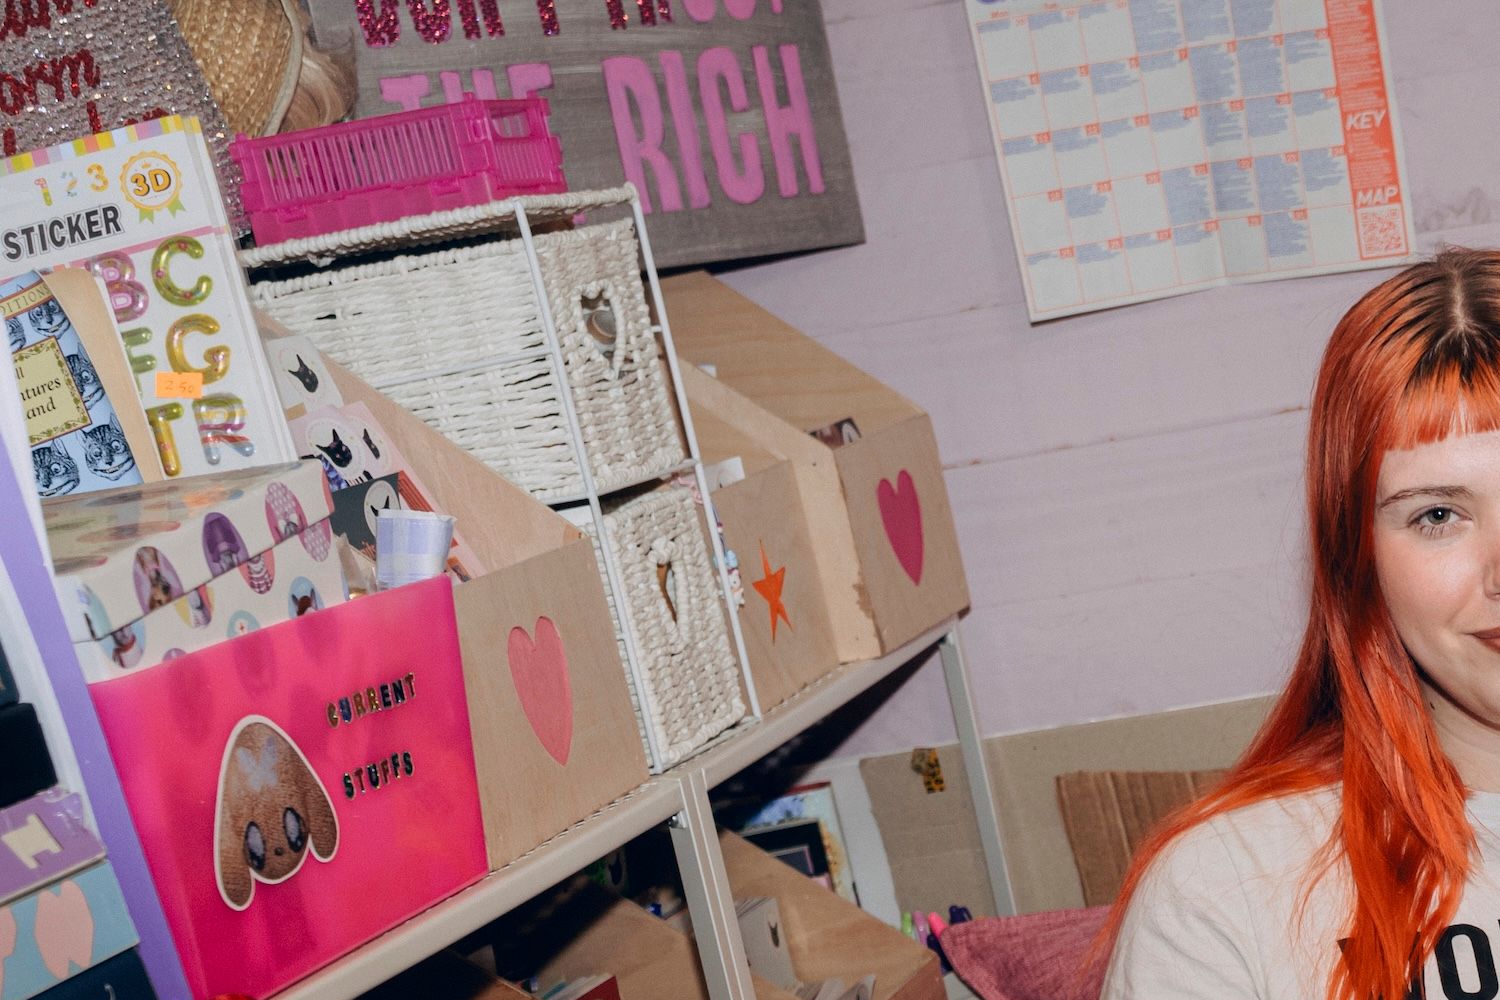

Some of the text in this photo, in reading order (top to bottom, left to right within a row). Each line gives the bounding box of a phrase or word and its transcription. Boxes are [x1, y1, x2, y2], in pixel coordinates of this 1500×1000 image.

[602, 43, 825, 215] RICH
[1346, 110, 1386, 130] KEY
[130, 168, 172, 197] 3D
[1356, 185, 1398, 207] MAP
[3, 204, 122, 261] STICKER
[151, 235, 213, 307] C
[165, 313, 231, 385] G
[192, 392, 256, 466] R
[326, 671, 416, 730] CURRENT
[343, 750, 414, 800] STUFFS
